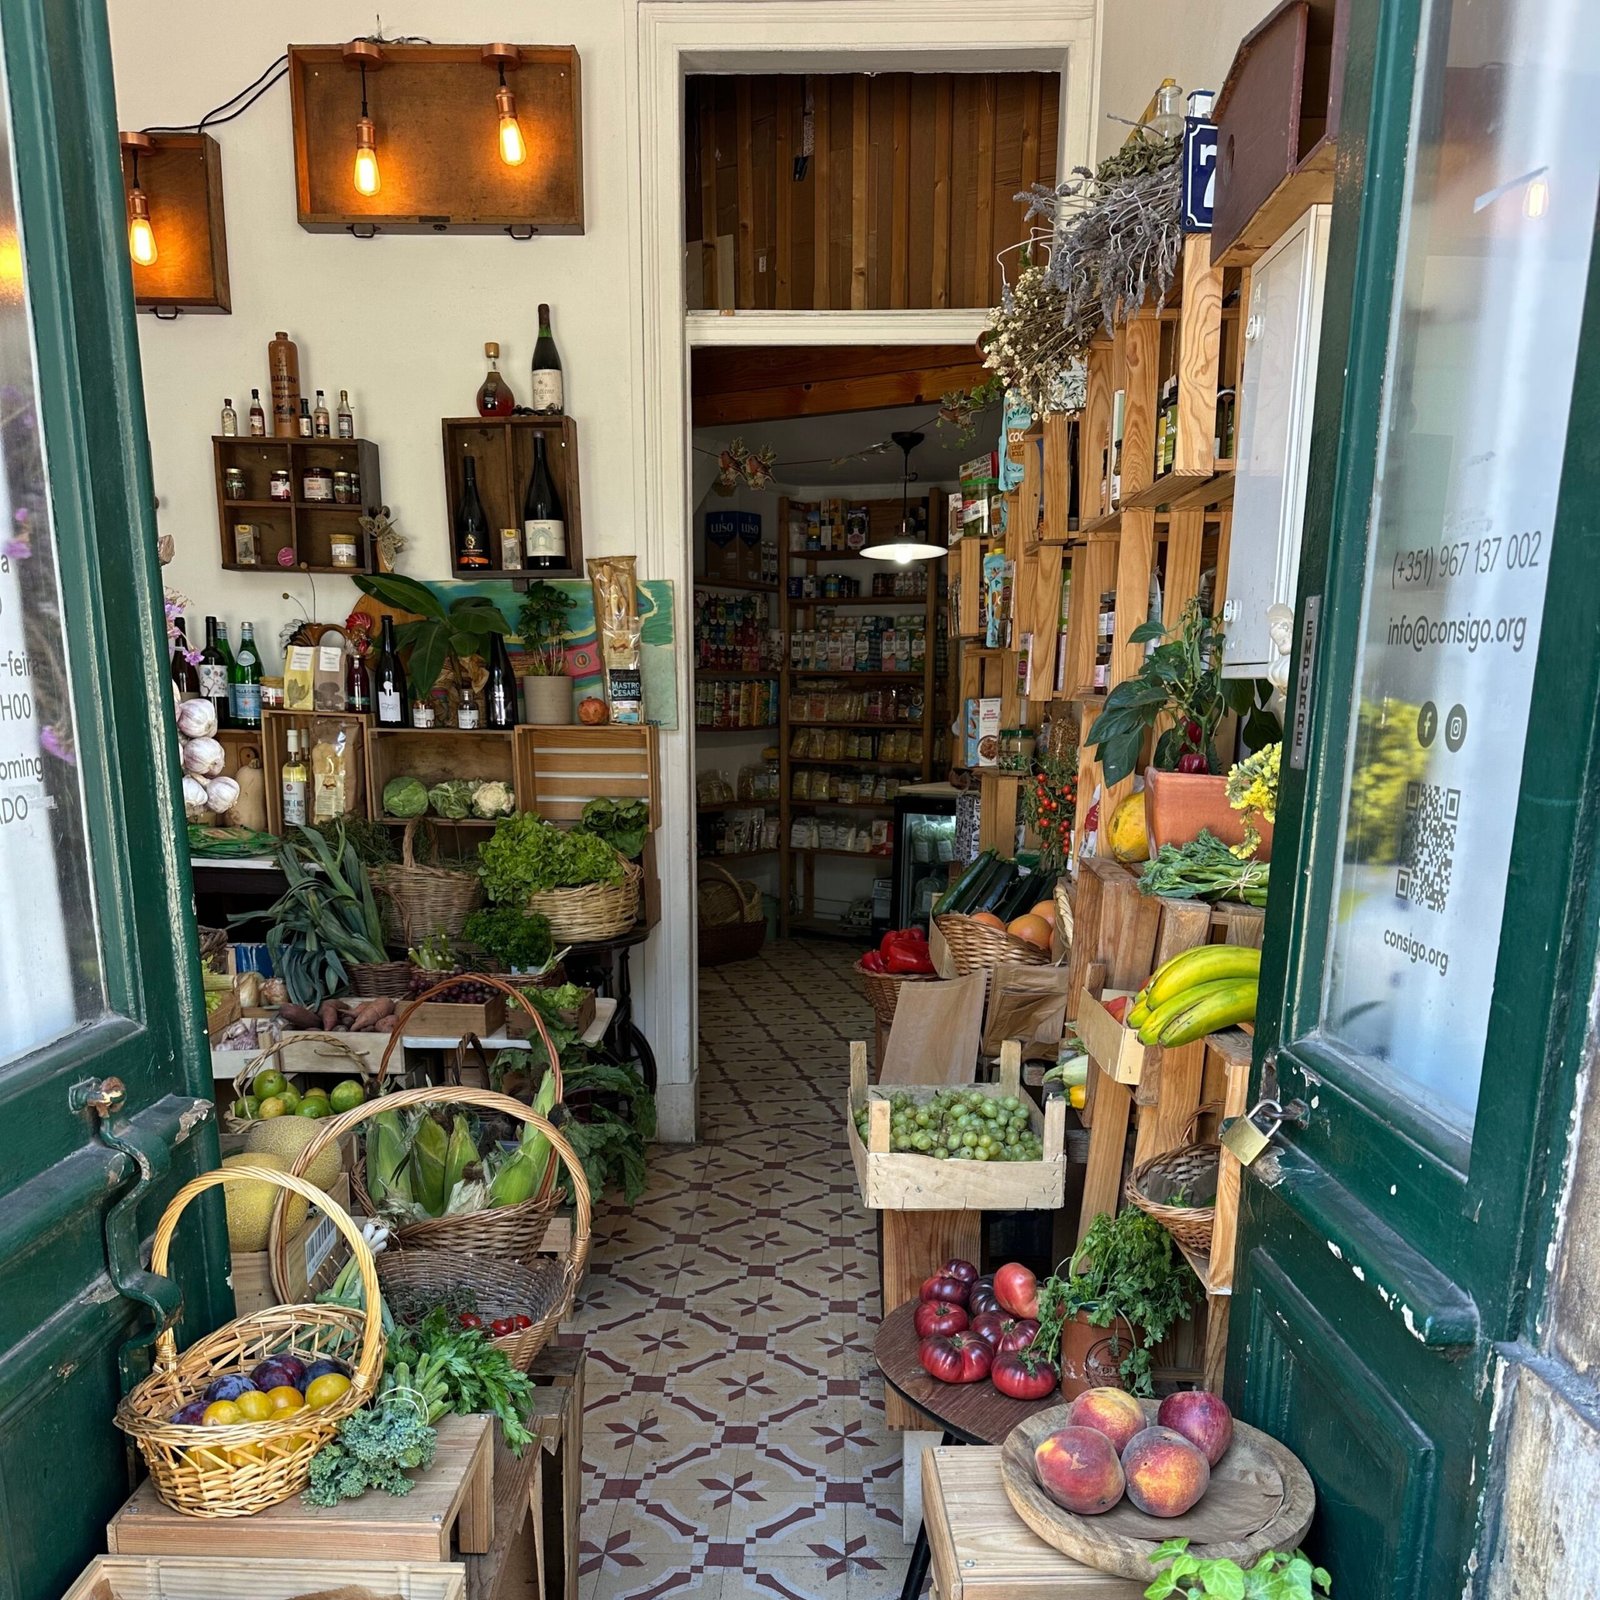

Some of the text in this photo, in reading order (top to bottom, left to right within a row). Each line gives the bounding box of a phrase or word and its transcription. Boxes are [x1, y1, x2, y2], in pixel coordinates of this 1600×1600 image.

[711, 522, 734, 533] LUSO
[742, 522, 760, 535] LUSO
[1392, 531, 1542, 590] (+351) 967 137 002
[1387, 612, 1528, 653] info@consigo.org
[611, 681, 640, 690] MASTRO
[612, 688, 641, 697] CESARE
[1296, 621, 1313, 747] EMPURRE
[0, 795, 28, 824] DO
[1383, 928, 1449, 977] consigo.org
